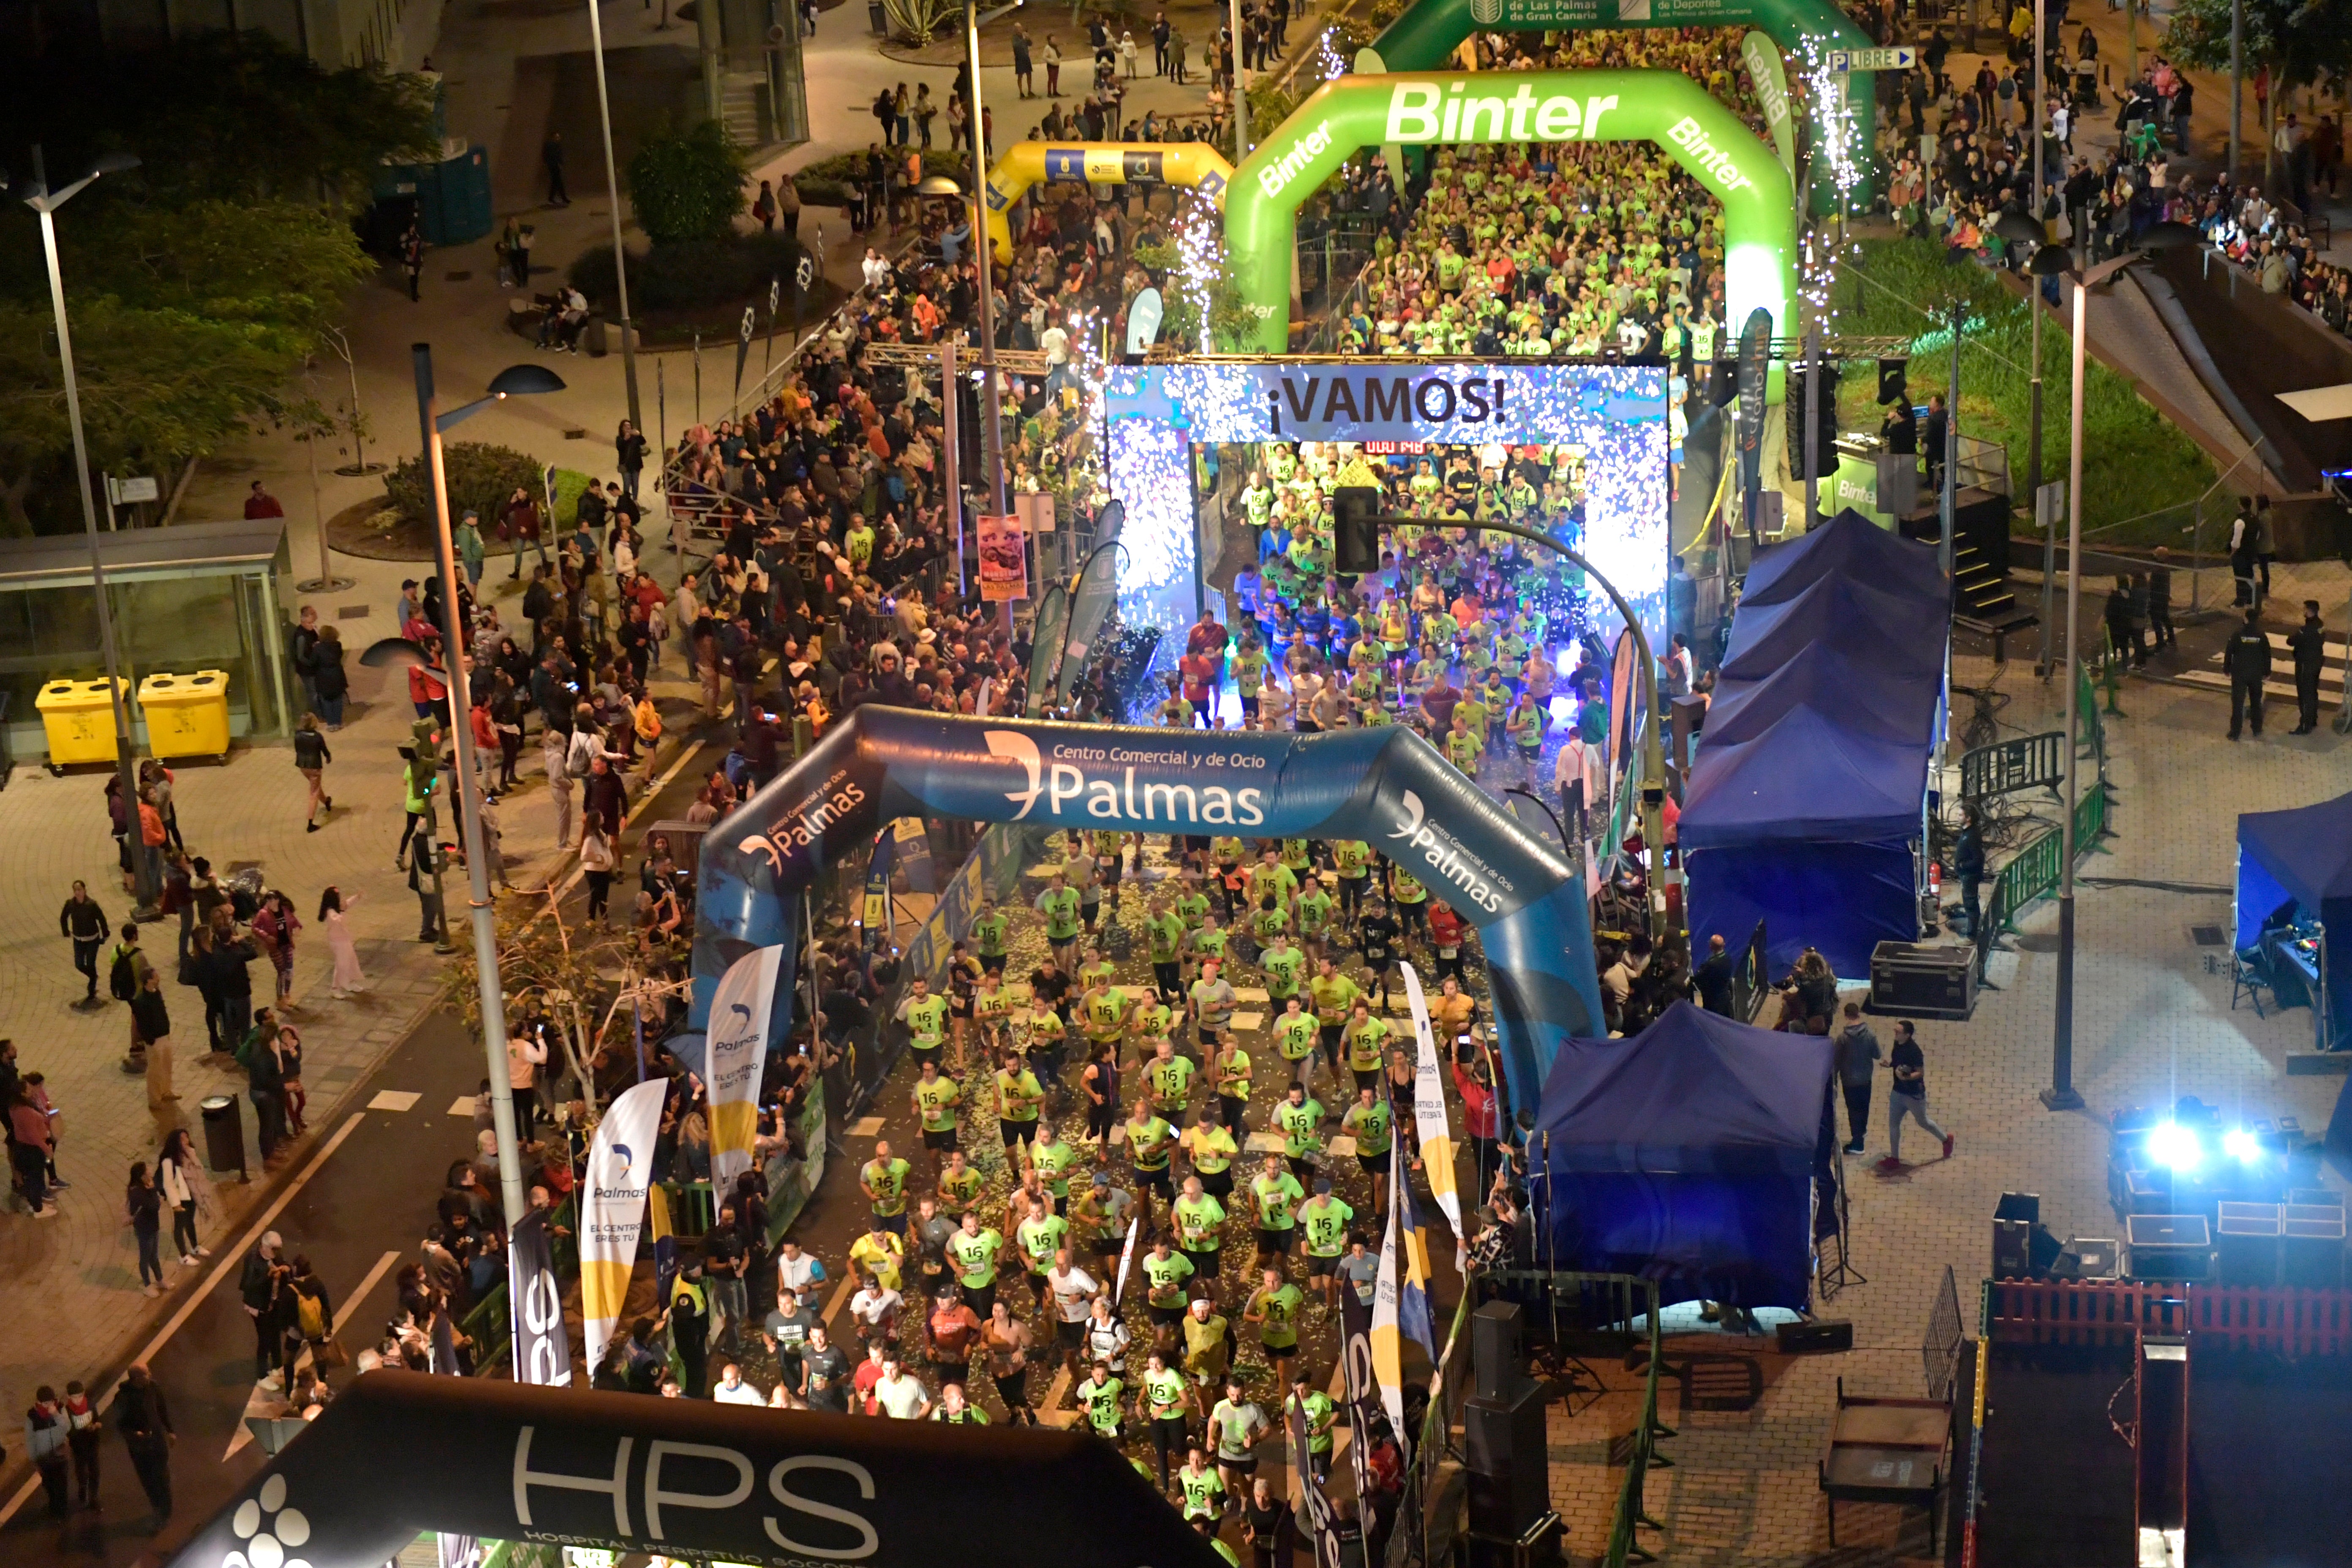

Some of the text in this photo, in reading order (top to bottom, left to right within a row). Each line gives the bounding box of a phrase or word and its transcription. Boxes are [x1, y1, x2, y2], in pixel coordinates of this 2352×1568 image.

[1509, 0, 1597, 11] de Las Palmas
[1658, 0, 1721, 11] de Deportes
[1510, 11, 1597, 21] de Gran Canaria
[1833, 50, 1892, 70] P LIBRE
[1385, 82, 1618, 143] Binter
[1258, 119, 1334, 198] Binter
[1667, 115, 1751, 191] Binter
[1268, 377, 1506, 434] ¡VAMOS!
[1838, 481, 1876, 505] Binte
[1489, 534, 1499, 542] 16
[1313, 562, 1325, 570] 16
[1281, 585, 1292, 593] 16
[1432, 626, 1443, 634] 16
[1524, 625, 1536, 633] 16
[1499, 645, 1510, 654] 16
[1362, 653, 1373, 662] 16
[1358, 689, 1371, 697] 16
[1487, 696, 1499, 705] 16
[1054, 744, 1266, 769] Centro Comercial y de Ocio
[1050, 763, 1264, 826] Palmas
[767, 817, 789, 835] Centro
[787, 791, 819, 818] Comercial
[822, 781, 832, 790] de
[772, 783, 865, 858] Palmas
[1098, 831, 1111, 841] 16
[1219, 849, 1231, 857] 16
[1342, 851, 1356, 861] 16
[1428, 819, 1451, 840] Centro
[1450, 837, 1484, 867] Comercial
[1488, 868, 1498, 879] de
[1497, 876, 1514, 892] Ocio
[1410, 826, 1503, 913] Palmas
[1263, 879, 1276, 888] 16
[1181, 906, 1196, 916] 16
[1303, 904, 1316, 914] 16
[1261, 920, 1276, 930] 16
[983, 927, 997, 937] 16
[1154, 929, 1167, 938] 16
[1203, 943, 1218, 952] 16
[1274, 963, 1288, 972] 16
[986, 1001, 1001, 1011] 16
[1097, 1005, 1112, 1015] 16
[915, 1011, 931, 1022] 16
[1033, 1022, 1045, 1031] 16
[1143, 1018, 1159, 1028] 16
[1289, 1026, 1304, 1037] 16
[1356, 1034, 1371, 1044] 16
[1162, 1070, 1178, 1081] 16
[923, 1092, 938, 1104] 16
[1004, 1088, 1020, 1097] 16
[1289, 1114, 1307, 1127] 16
[1363, 1117, 1380, 1129] 16
[1039, 1158, 1054, 1167] 16
[877, 1176, 893, 1187] 16
[951, 1182, 967, 1192] 16
[594, 1187, 646, 1198] Palmas
[1185, 1213, 1201, 1225] 16
[1315, 1218, 1332, 1230] 16
[604, 1222, 641, 1232] CENTRO
[1033, 1233, 1050, 1246] 16
[966, 1246, 983, 1258] 16
[1155, 1270, 1171, 1281] 16
[1266, 1300, 1284, 1312] 16
[1149, 1383, 1166, 1396] 16
[1092, 1394, 1111, 1407] 16
[513, 1426, 879, 1560] HPS
[1188, 1483, 1206, 1497] 16
[523, 1530, 636, 1551] HOSPITAL
[643, 1544, 763, 1565] PERPETUO
